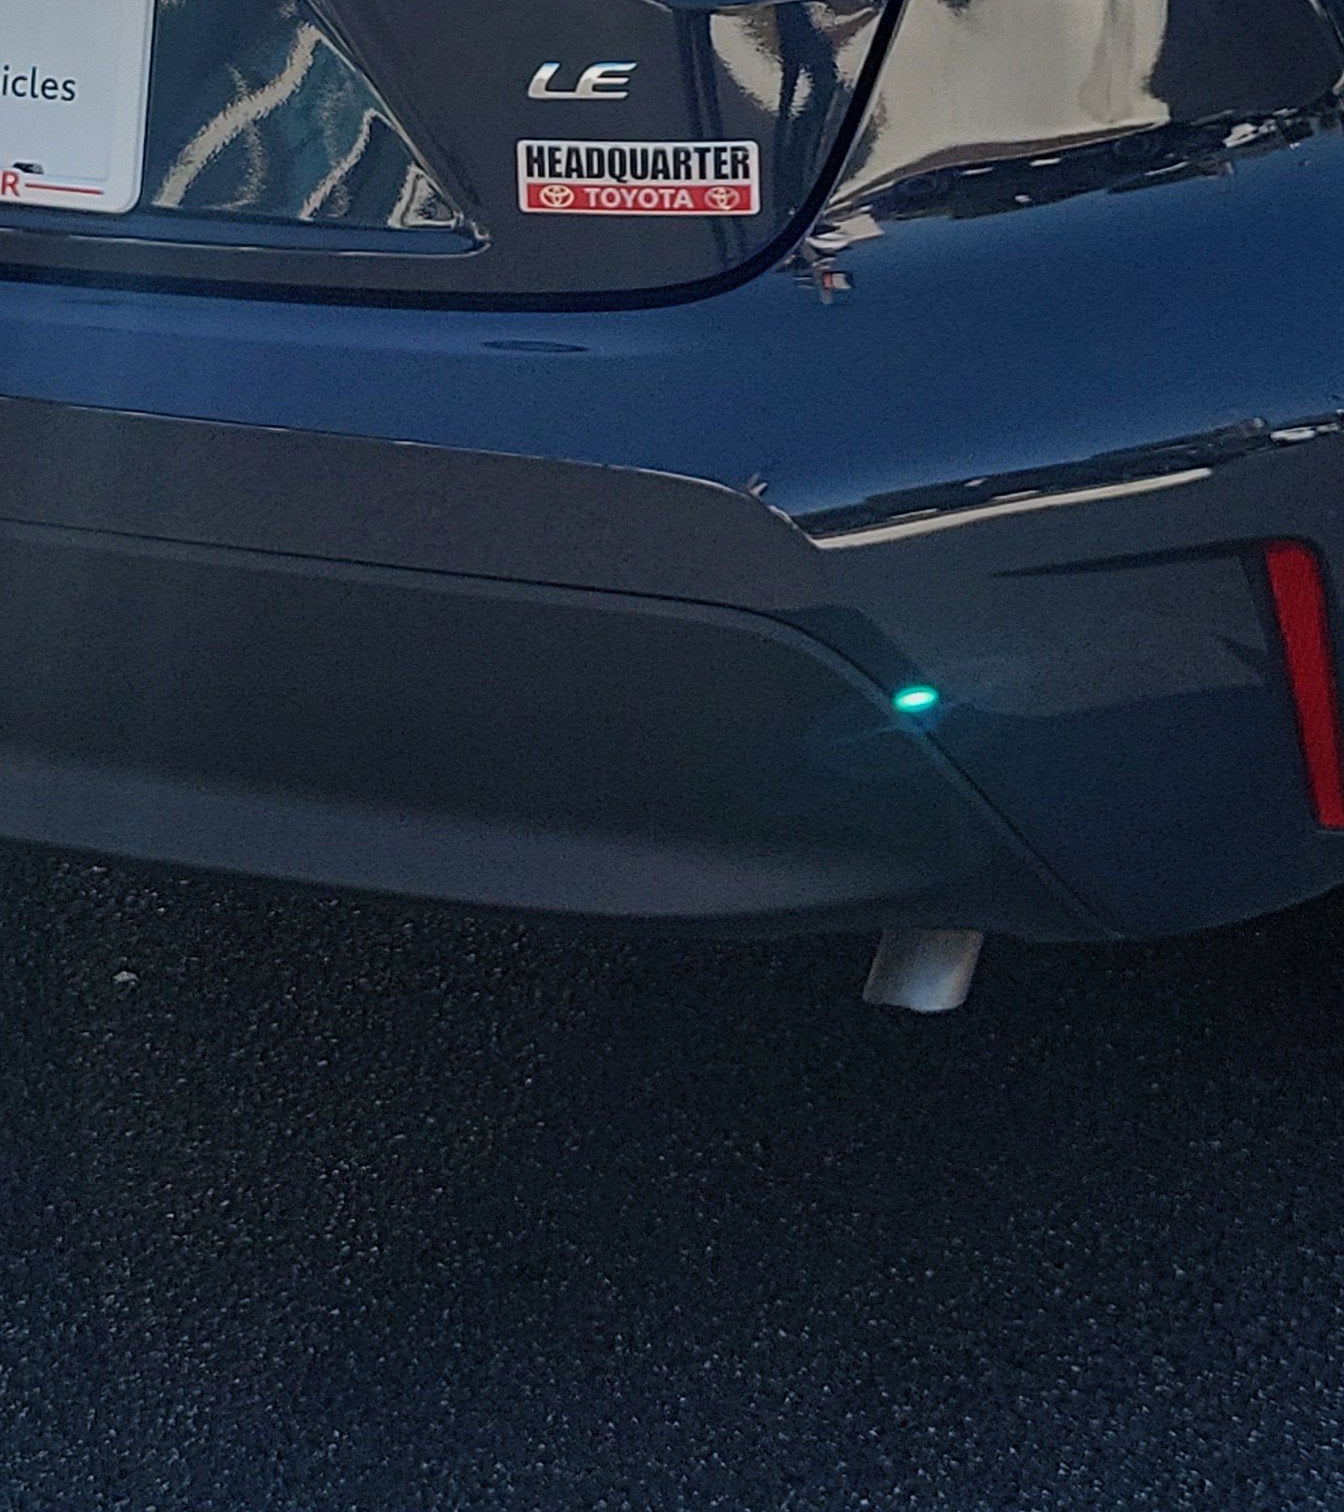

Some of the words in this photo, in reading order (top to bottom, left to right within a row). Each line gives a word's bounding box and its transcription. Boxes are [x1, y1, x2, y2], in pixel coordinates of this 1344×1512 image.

[527, 60, 638, 100] LE
[525, 144, 751, 183] HEADQUARTER
[583, 186, 694, 209] TOYOTA
